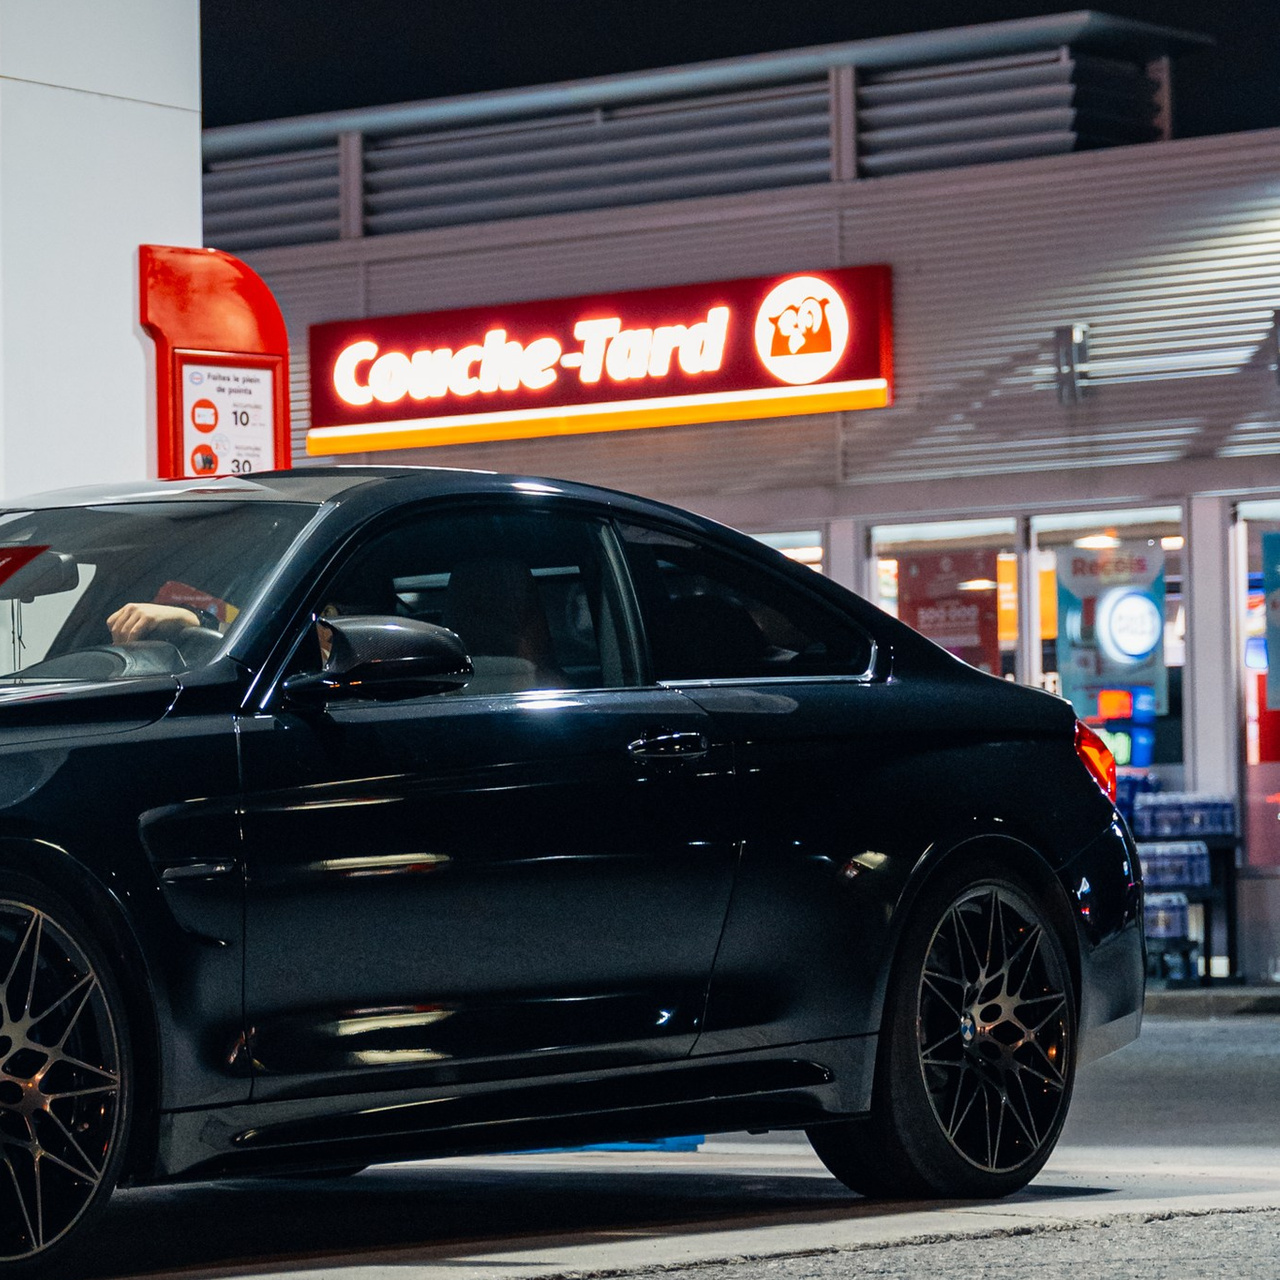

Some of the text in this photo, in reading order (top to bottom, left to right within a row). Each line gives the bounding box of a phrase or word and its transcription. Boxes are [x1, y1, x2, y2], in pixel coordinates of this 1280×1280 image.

[332, 306, 730, 406] Couche-Tard
[232, 410, 250, 426] 10
[231, 459, 252, 474] 30
